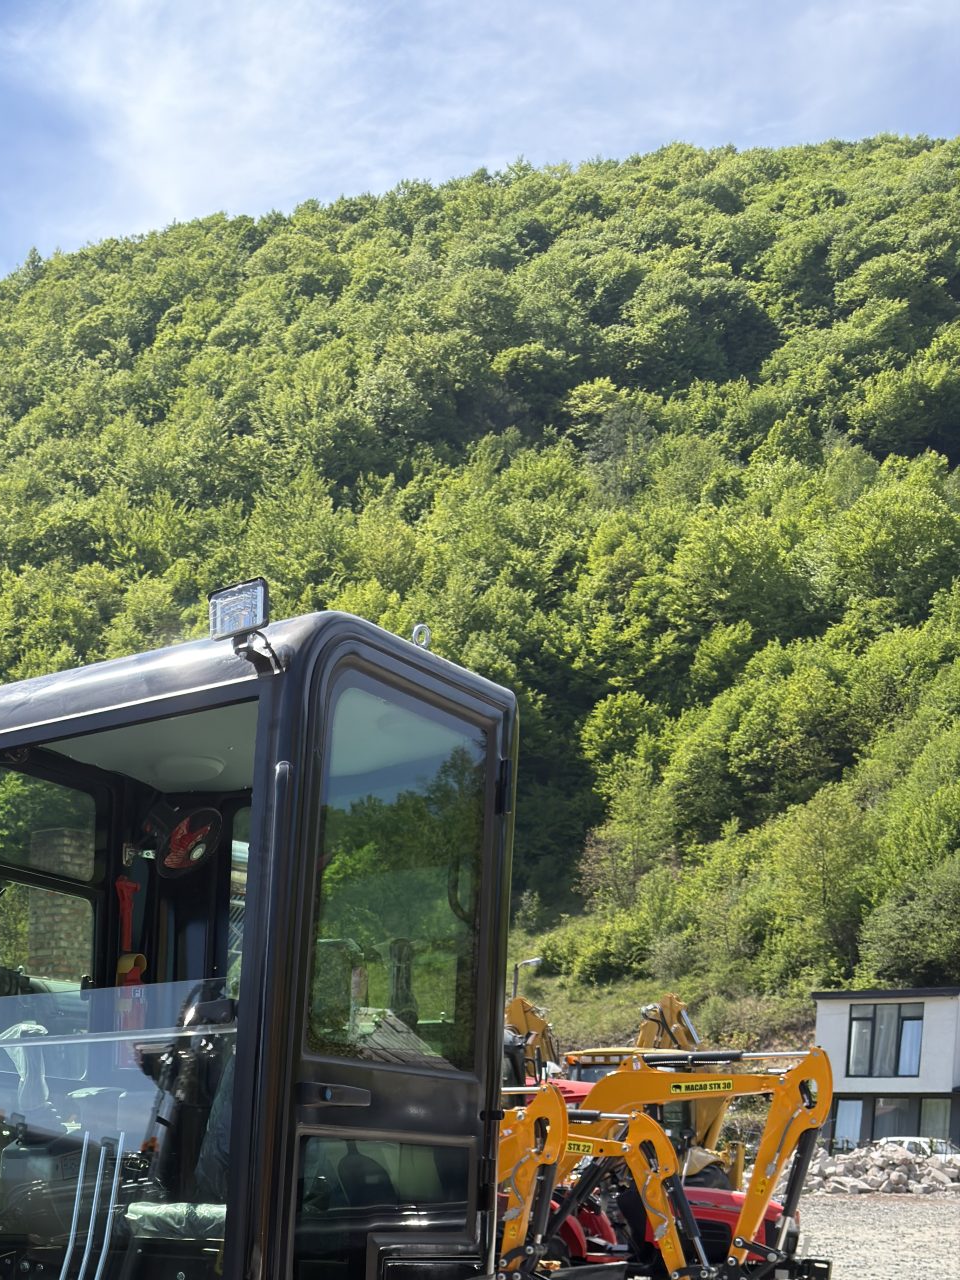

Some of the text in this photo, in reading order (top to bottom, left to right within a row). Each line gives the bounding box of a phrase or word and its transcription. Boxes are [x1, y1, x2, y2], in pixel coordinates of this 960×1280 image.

[684, 1081, 732, 1092] MACAO STX 30
[567, 1142, 591, 1153] STX 22
